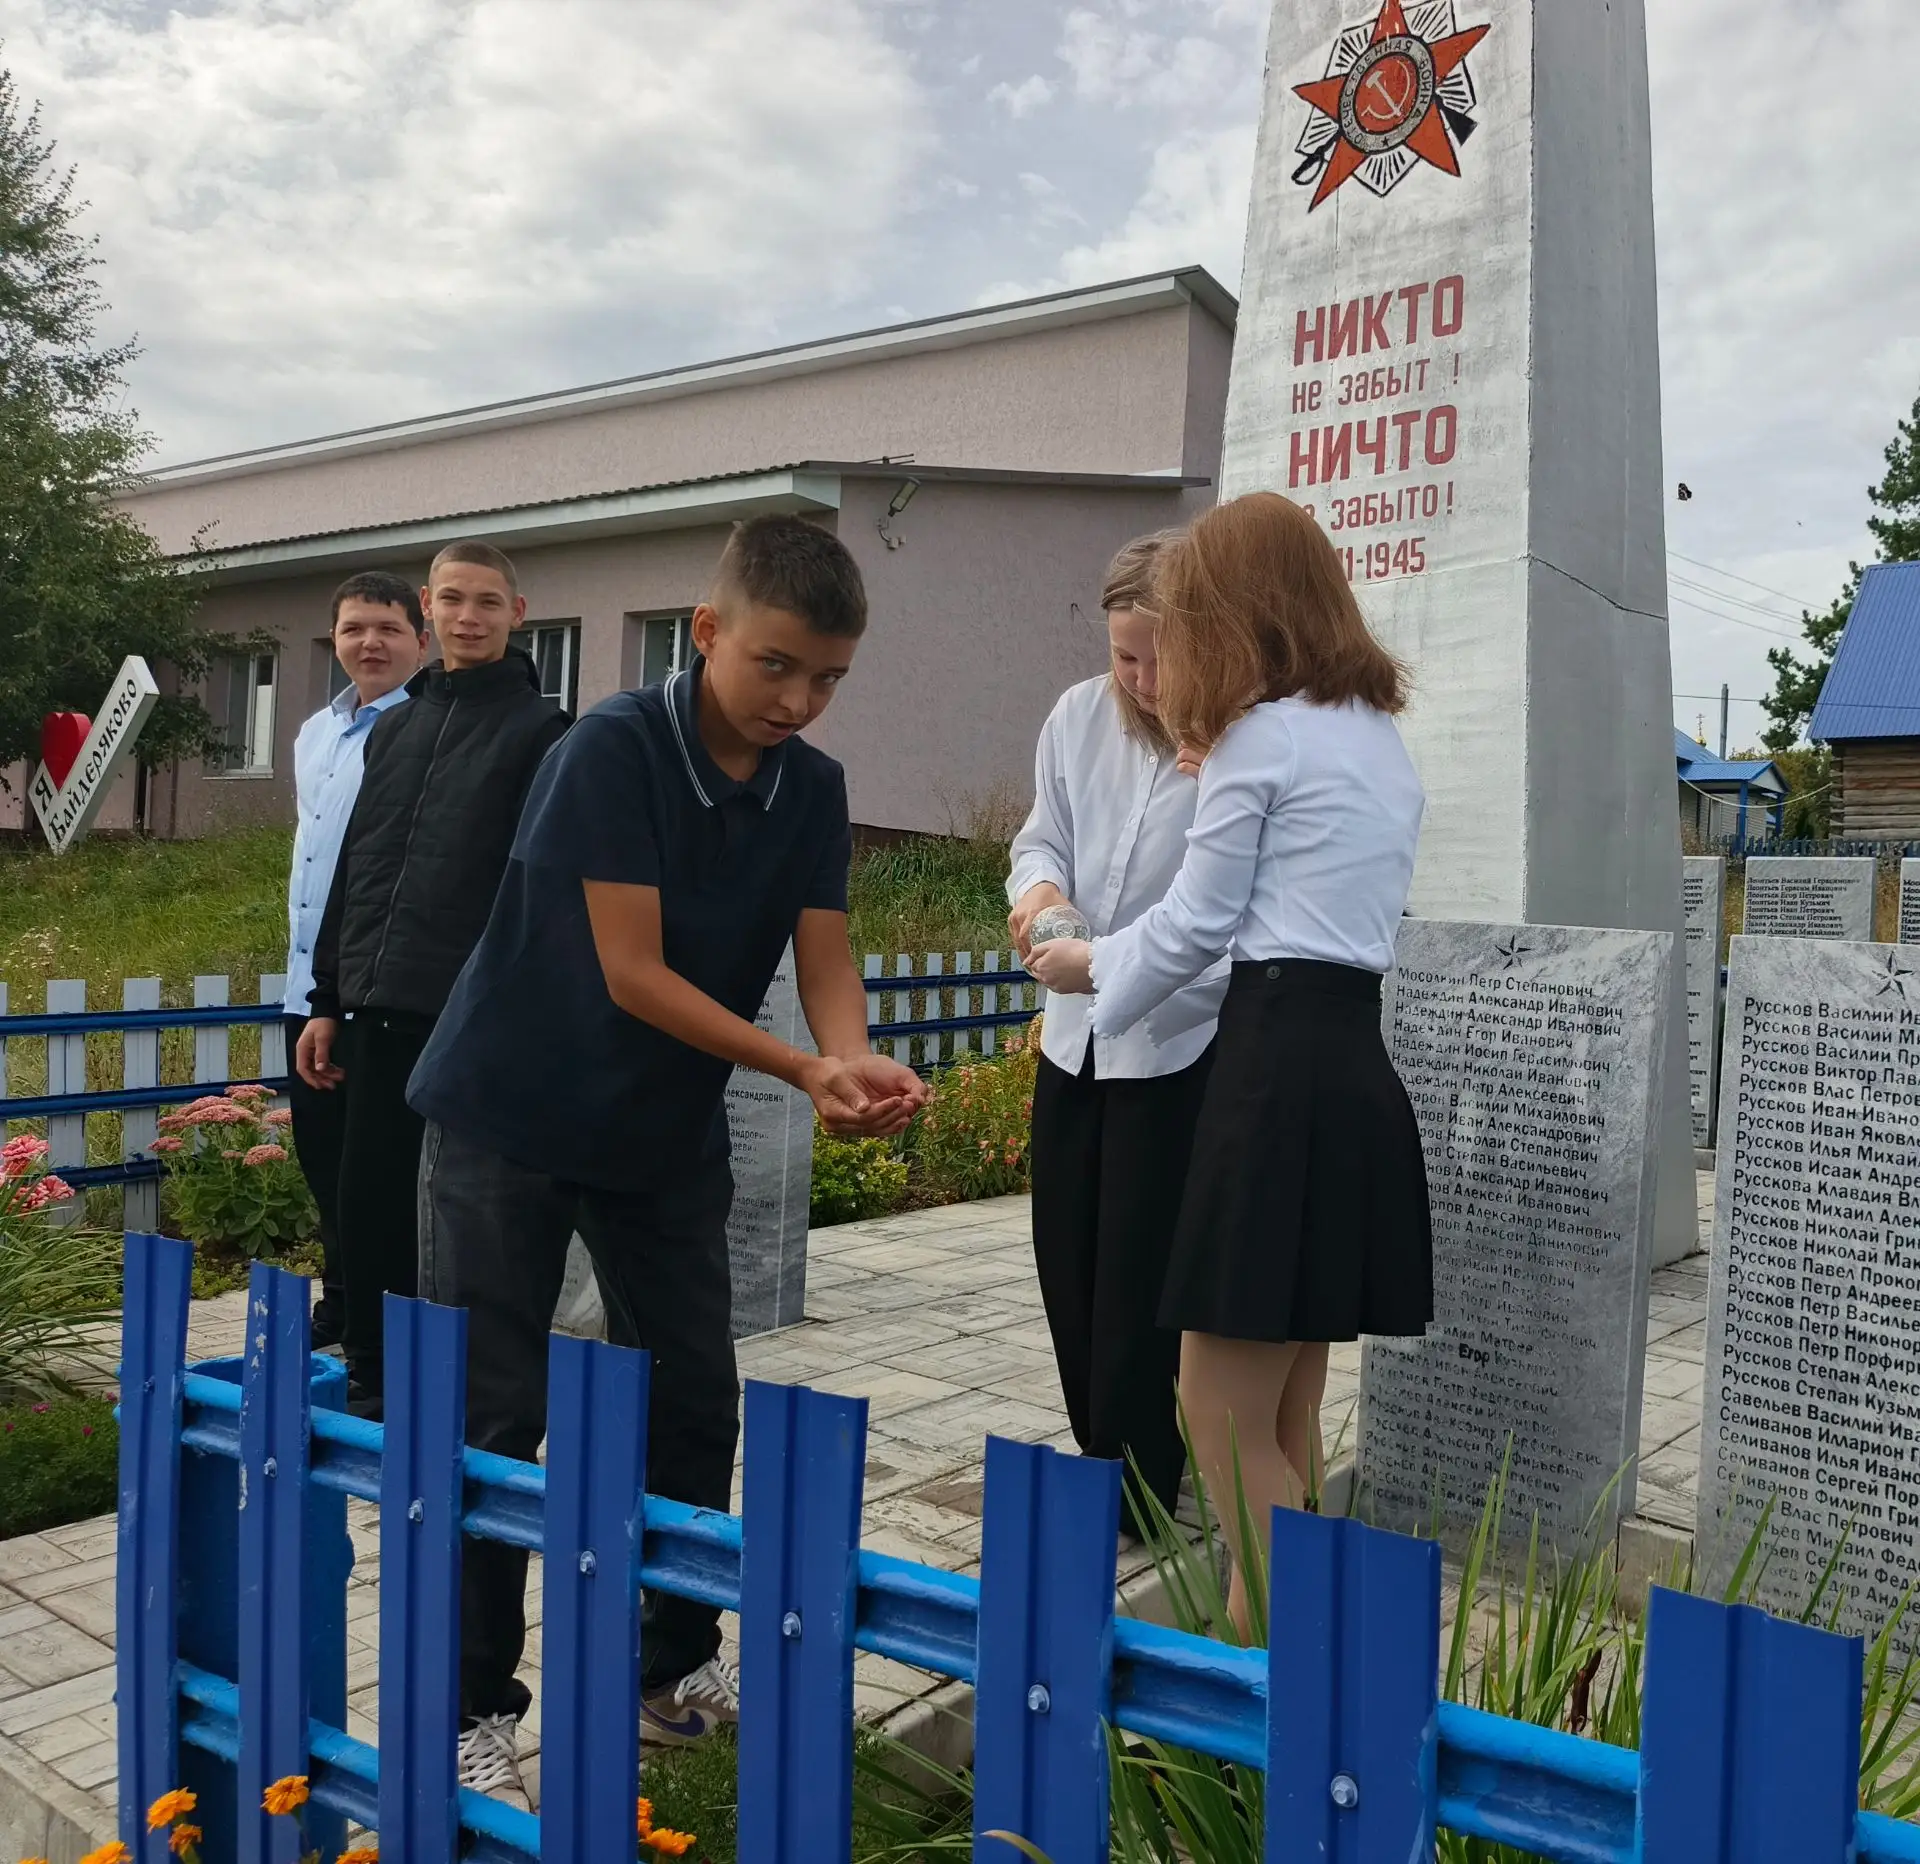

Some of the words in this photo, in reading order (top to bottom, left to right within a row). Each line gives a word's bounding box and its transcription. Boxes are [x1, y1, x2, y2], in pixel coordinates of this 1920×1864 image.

[1293, 274, 1464, 367] НИКТО
[1292, 380, 1322, 414] не
[1289, 404, 1457, 488] НИЧТО
[1336, 537, 1425, 581] 1-1945
[34, 772, 53, 815] Я
[1396, 984, 1463, 1003] Надеждин
[1468, 991, 1543, 1013] Александр
[1548, 998, 1622, 1017] Иванович
[1469, 973, 1500, 991] Петр
[1505, 976, 1592, 996] Степанович
[1395, 1001, 1462, 1020] Надеждин
[1467, 1008, 1542, 1031] Александр
[1547, 1016, 1621, 1036] Иванович
[1744, 997, 1812, 1015] Руссков
[1394, 1018, 1461, 1037] Надеждин
[1466, 1025, 1496, 1044] Егор
[1501, 1029, 1572, 1049] Иванович
[1742, 1016, 1810, 1035] Руссков
[1393, 1035, 1460, 1055] Надеждин
[1512, 1048, 1610, 1072] Герасимович
[1741, 1035, 1809, 1054] Руссков
[1391, 1052, 1458, 1072] Надеждин
[1527, 1068, 1600, 1089] Иванович
[1739, 1074, 1806, 1094] Руссков
[1813, 1081, 1854, 1098] Влас
[1740, 1054, 1808, 1074] Руссков
[1814, 1061, 1876, 1085] Виктор
[1883, 1067, 1920, 1085] Пав
[724, 1089, 784, 1104] лександрович
[1393, 1070, 1457, 1090] адеждин
[1462, 1078, 1493, 1097] Петр
[1498, 1083, 1584, 1106] Алексеевич
[1409, 1089, 1444, 1107] заров
[1513, 1102, 1604, 1127] Михайлович
[1738, 1093, 1805, 1113] Руссков
[1812, 1100, 1855, 1119] Иван
[1448, 1112, 1482, 1128] Иван
[1487, 1117, 1600, 1145] Александрович
[1737, 1111, 1804, 1132] Руссков
[1810, 1119, 1854, 1138] Иван
[1446, 1147, 1495, 1166] Степан
[1499, 1155, 1586, 1181] Васильевич
[1510, 1138, 1597, 1163] Степанович
[1734, 1150, 1802, 1172] Руссков
[1808, 1159, 1861, 1180] Исаак
[1736, 1131, 1803, 1153] Руссков
[1809, 1139, 1850, 1158] Илья
[1857, 1144, 1920, 1166] Михай
[1455, 1165, 1530, 1192] Александр
[1535, 1178, 1608, 1202] Иванович
[1733, 1168, 1810, 1193] Русскова
[1818, 1180, 1890, 1204] Клавдия
[1516, 1194, 1590, 1218] Иванович
[1732, 1188, 1799, 1211] Руссков
[1806, 1198, 1873, 1221] Михаил
[1466, 1203, 1541, 1231] Александр
[1546, 1217, 1621, 1243] Иванович
[1731, 1207, 1798, 1230] Руссков
[1805, 1217, 1878, 1242] Николай
[1527, 1232, 1608, 1259] Данилович
[1728, 1245, 1796, 1270] Руссков
[1802, 1257, 1854, 1279] Павел
[1730, 1226, 1797, 1250] Руссков
[1803, 1237, 1877, 1263] Николай
[1727, 1264, 1795, 1289] Руссков
[1801, 1276, 1840, 1301] Петр
[1726, 1283, 1793, 1308] Руссков
[1800, 1296, 1839, 1321] Петр
[1725, 1303, 1793, 1328] Руссков
[1799, 1316, 1838, 1341] Петр
[1458, 1344, 1489, 1368] Егор
[1724, 1322, 1792, 1348] Руссков
[1799, 1336, 1838, 1361] Петр
[1723, 1343, 1791, 1370] Руссков
[1797, 1358, 1859, 1384] Степан
[1721, 1364, 1789, 1391] Руссков
[1796, 1379, 1858, 1406] Степан
[1720, 1386, 1801, 1417] Савельев
[1807, 1404, 1882, 1434] Василий
[1719, 1405, 1811, 1439] Селиванов
[1817, 1427, 1903, 1460] Илларион
[1719, 1425, 1810, 1460] Селиванов
[1816, 1447, 1858, 1470] Илья
[1717, 1445, 1809, 1480] Селиванов
[1815, 1468, 1877, 1496] Сергей
[1815, 1488, 1881, 1518] Филипп
[1781, 1501, 1820, 1524] Влас
[1827, 1512, 1912, 1547] Петрович
